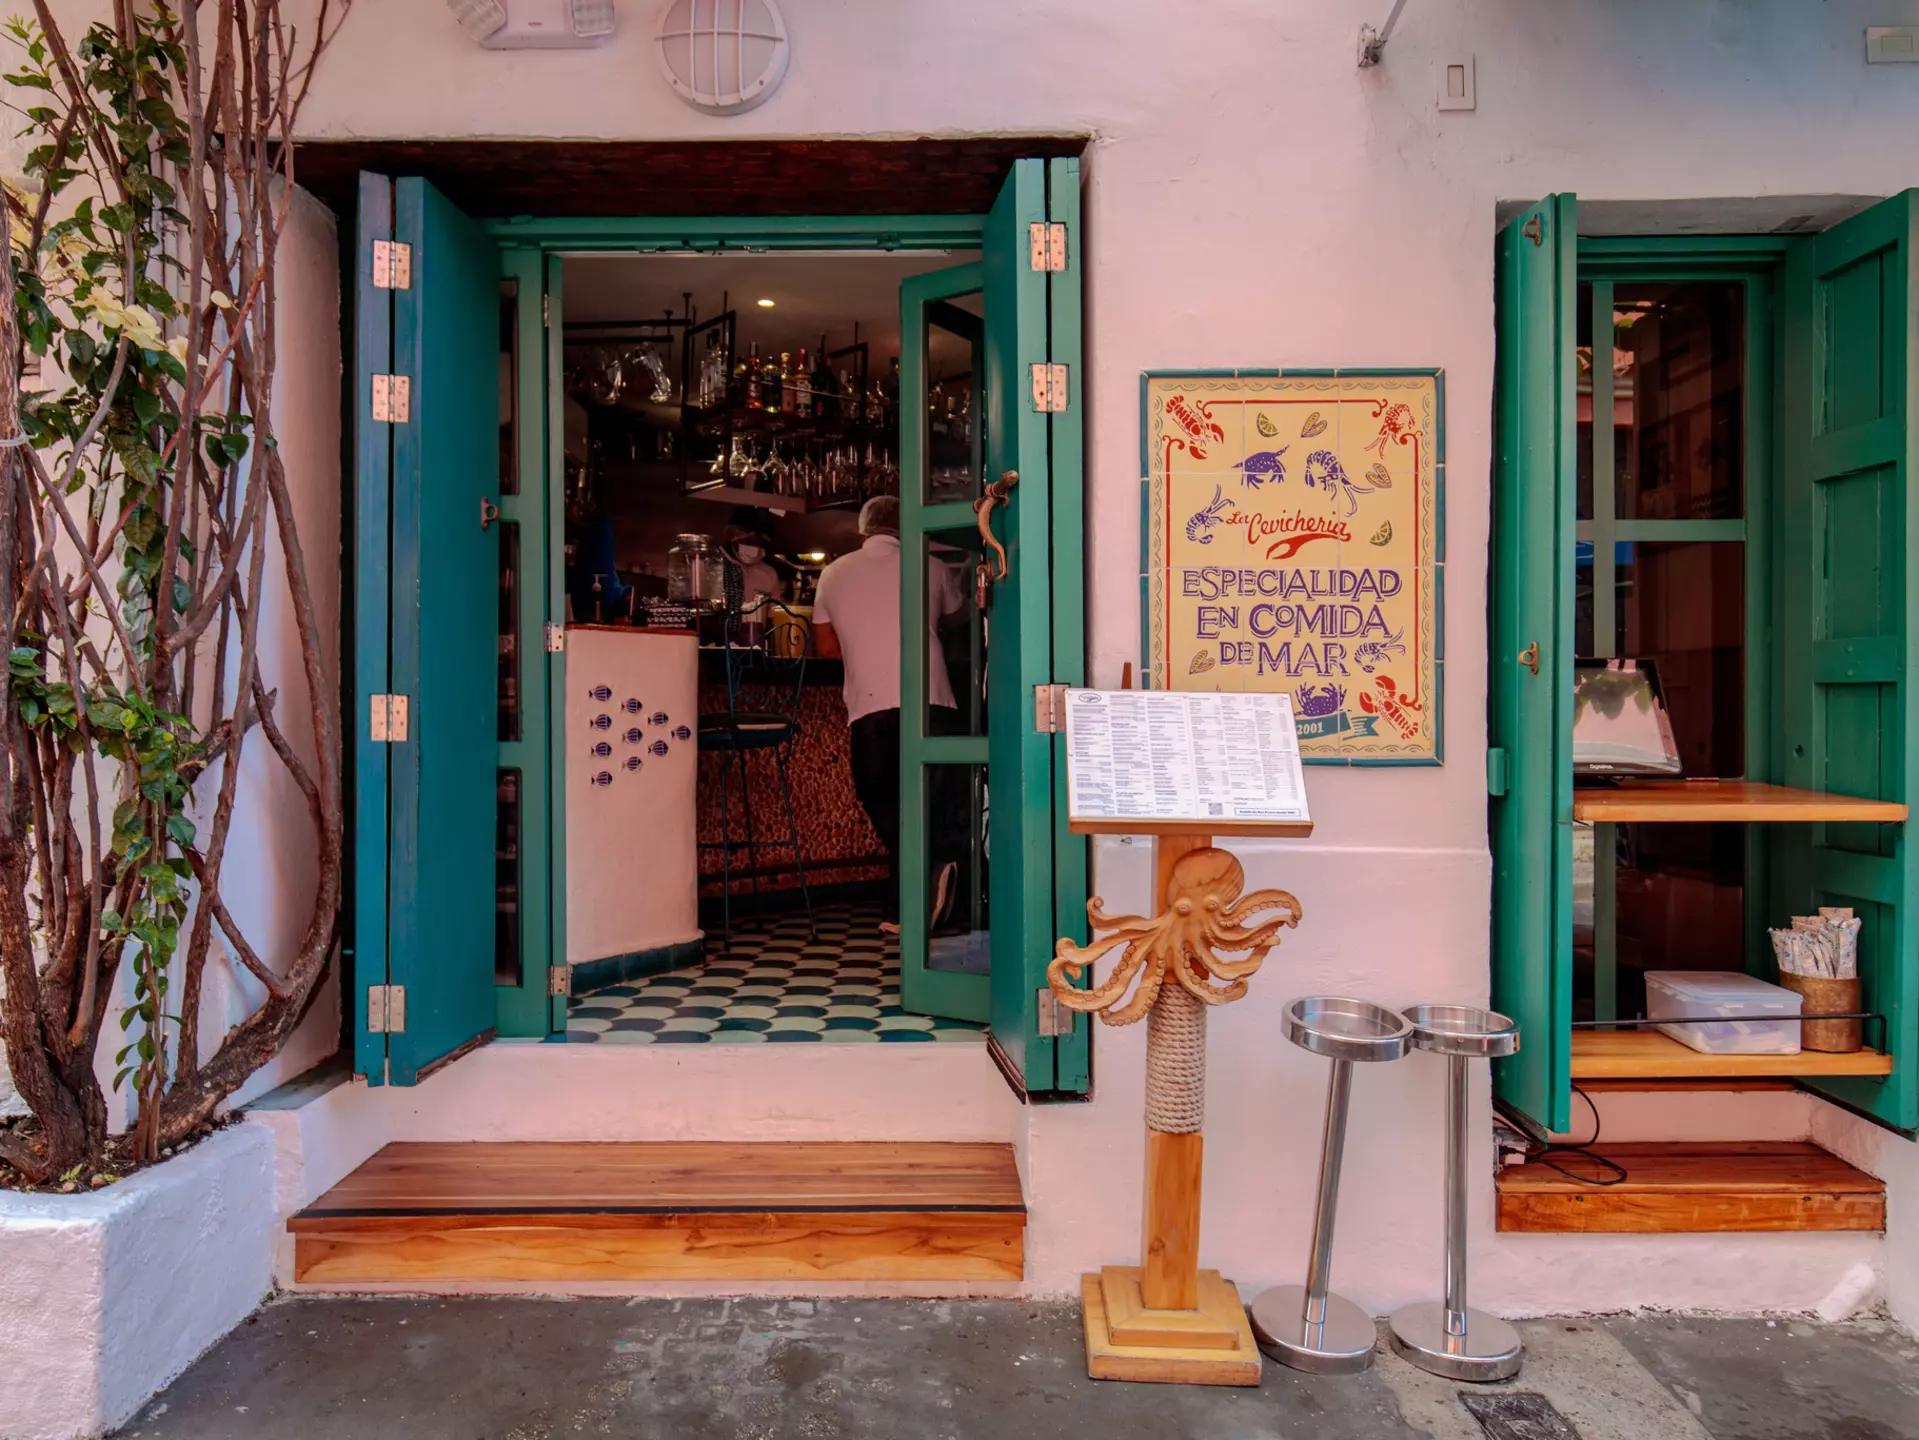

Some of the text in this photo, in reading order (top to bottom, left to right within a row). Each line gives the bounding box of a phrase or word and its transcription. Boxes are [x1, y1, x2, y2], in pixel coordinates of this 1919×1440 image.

[1226, 511, 1249, 524] La
[1182, 566, 1402, 602] ESPECIALIDAD
[1196, 603, 1393, 639] EN COMIDA
[1219, 641, 1350, 676] DE MAR
[1297, 721, 1324, 735] 2001
